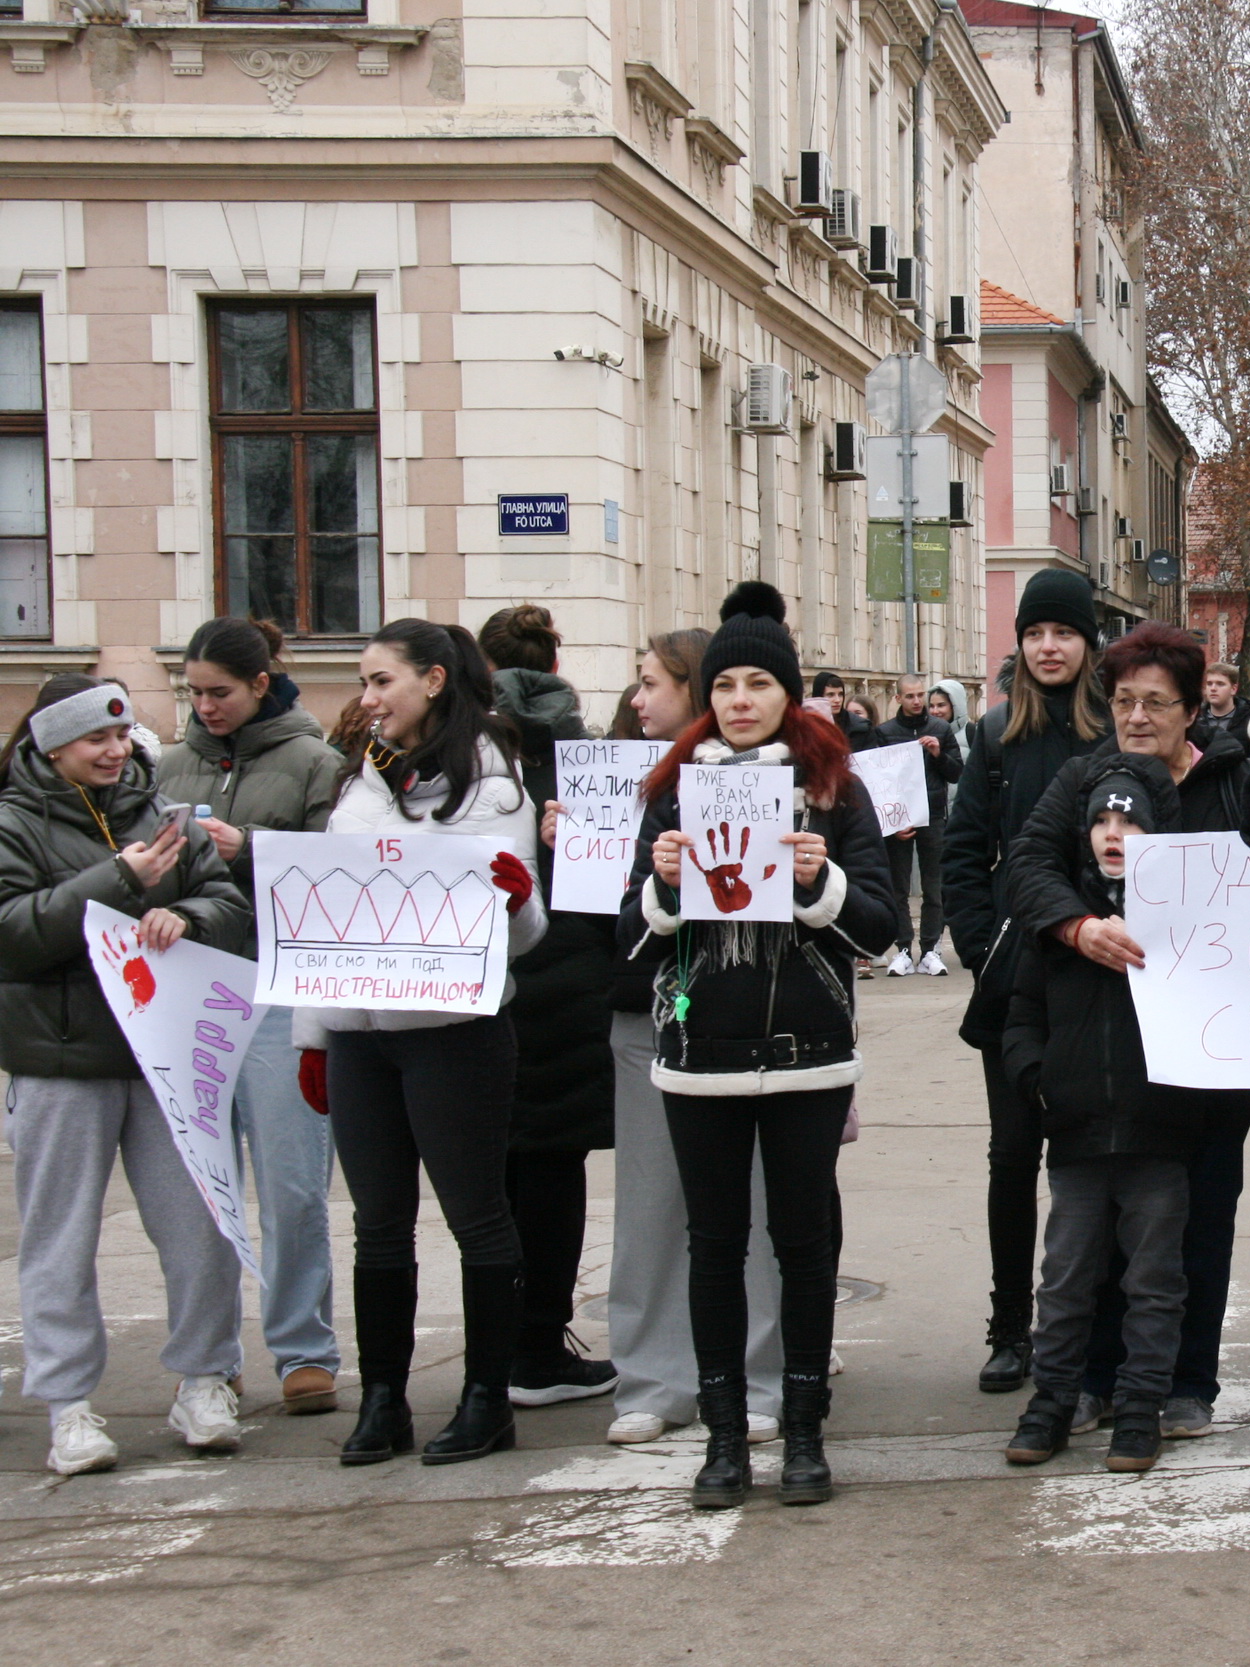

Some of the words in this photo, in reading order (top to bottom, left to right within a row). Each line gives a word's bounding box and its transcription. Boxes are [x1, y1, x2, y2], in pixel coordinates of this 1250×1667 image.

[501, 502, 535, 514] ГЛАВНА
[535, 501, 567, 515] УЛИЦА
[529, 515, 553, 528] UTCA
[560, 744, 620, 768] КОМЕ
[639, 744, 661, 770] Д
[696, 769, 728, 788] РУКЕ
[742, 771, 760, 788] СУ
[715, 788, 752, 805] ВАМ
[563, 805, 630, 834] КАДА
[700, 797, 781, 822] КРВАВЕ!
[375, 838, 403, 863] 15
[564, 835, 639, 862] СИСТ
[294, 952, 327, 969] СВИ
[335, 954, 366, 968] СМО
[376, 956, 397, 970] МИ
[294, 975, 483, 1006] НАДСТРЕШНИЦОМ!
[189, 981, 253, 1139] happy
